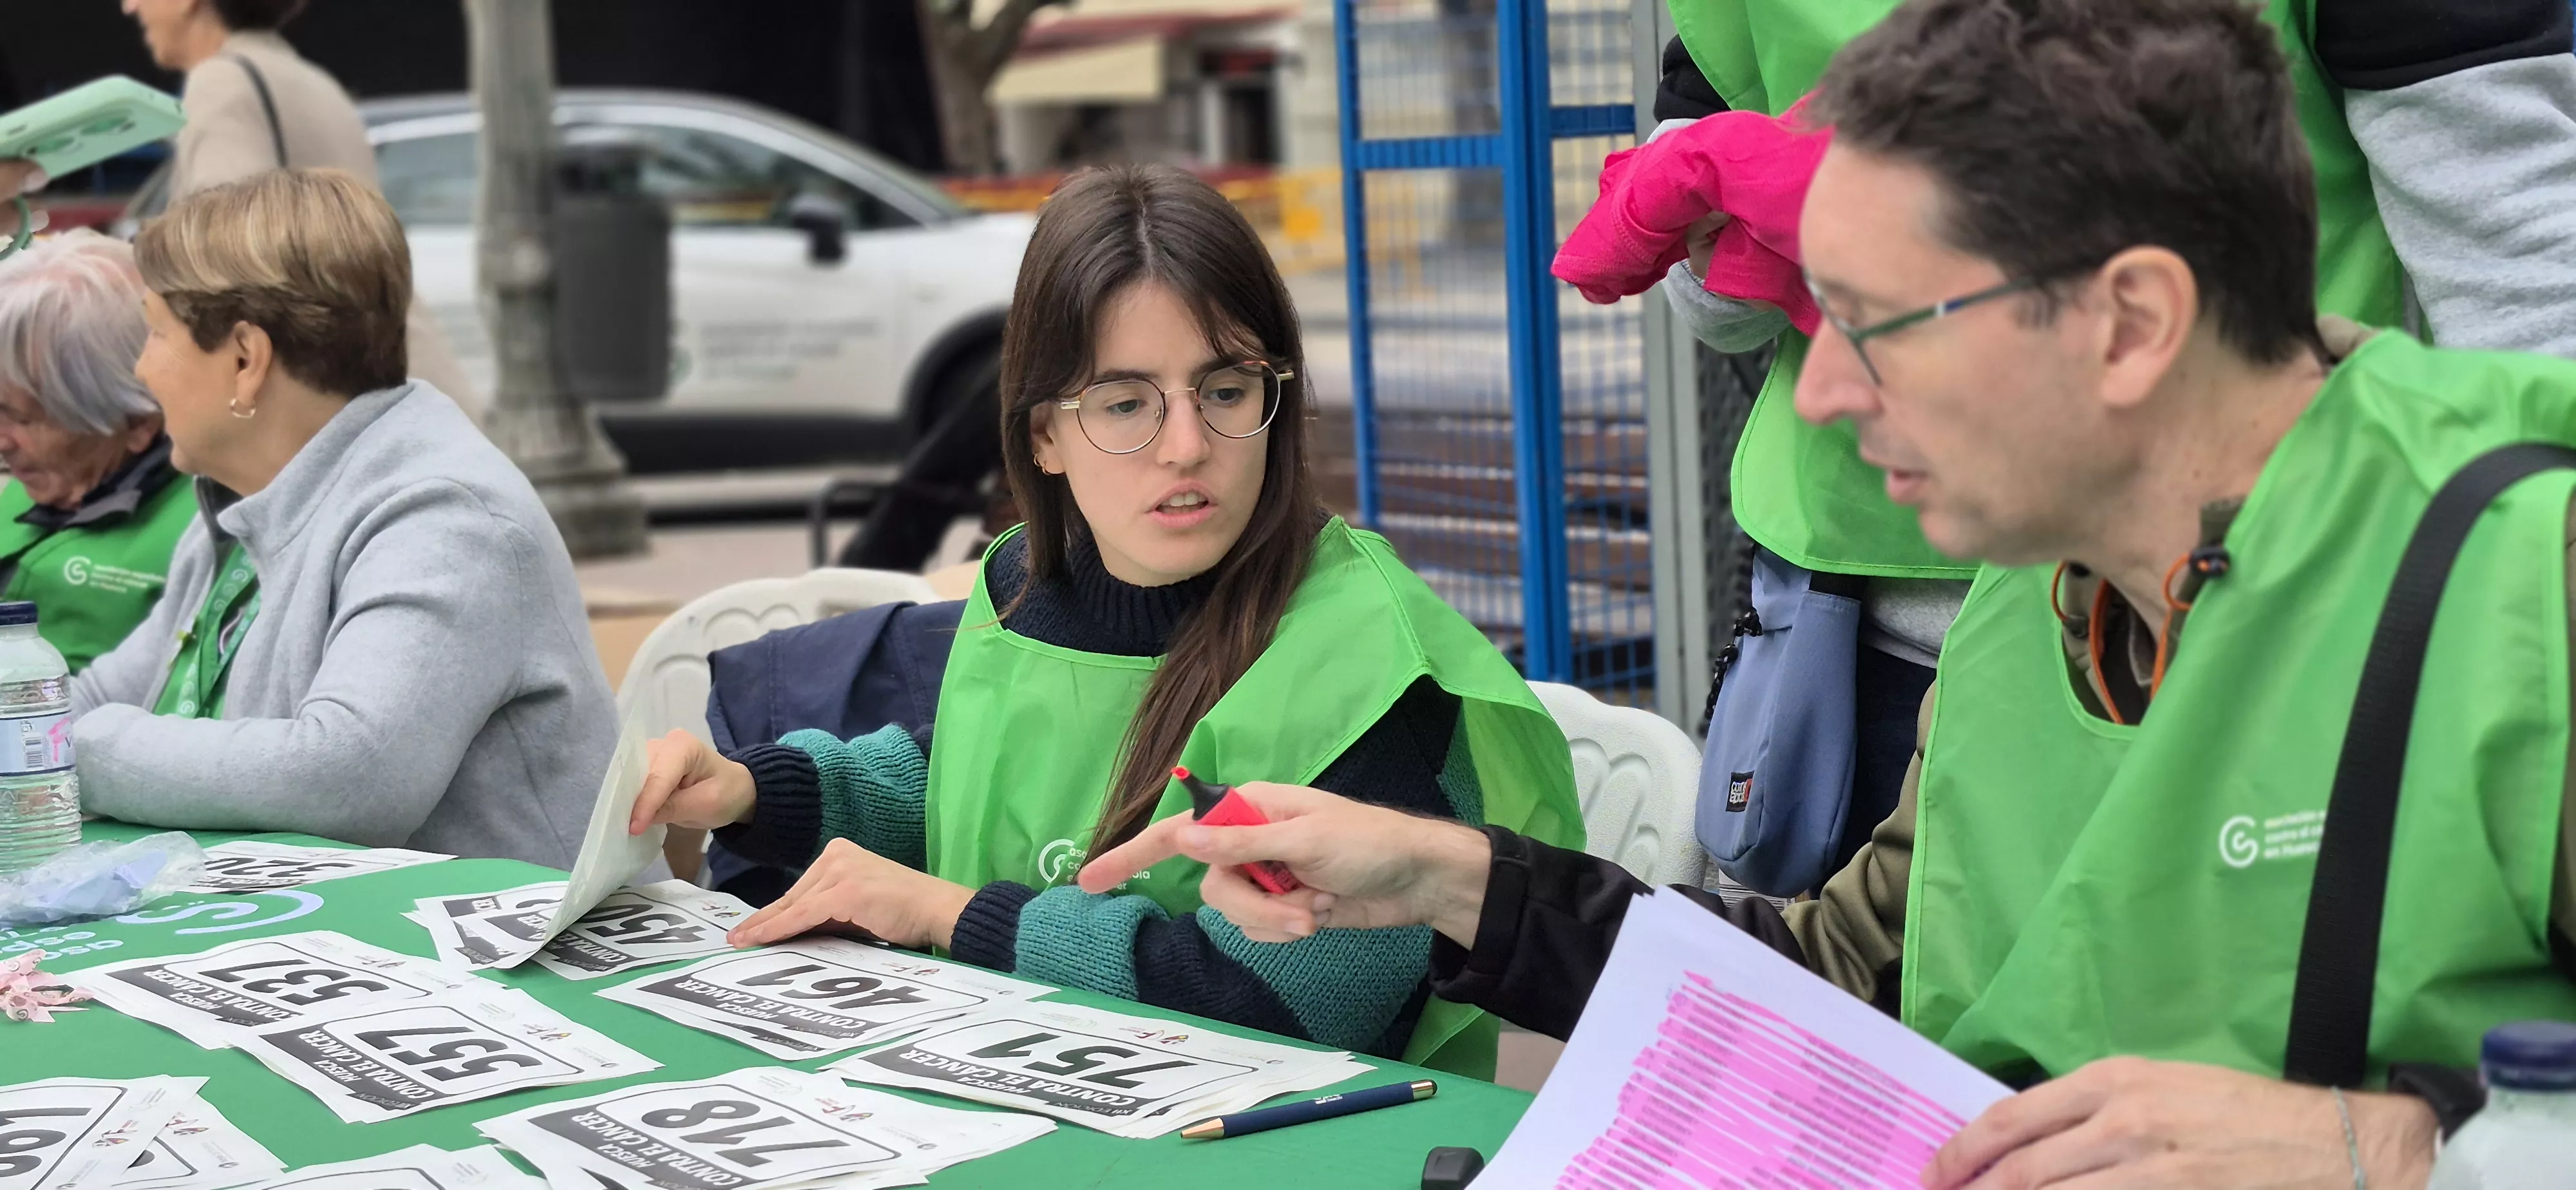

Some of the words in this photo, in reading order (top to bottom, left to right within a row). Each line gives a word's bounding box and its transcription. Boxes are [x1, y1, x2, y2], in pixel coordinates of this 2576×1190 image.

[572, 904, 708, 945] 450
[566, 939, 628, 963] CONTRA
[143, 968, 213, 999] CÁNCER
[198, 959, 390, 1006] 537
[674, 979, 757, 1004] CÁNCER
[735, 965, 931, 1010] 461
[168, 992, 221, 1011] HUESCA
[211, 990, 230, 1006] EL
[230, 996, 295, 1021] CONTRA
[758, 999, 783, 1013] EL
[715, 1002, 779, 1020] HUESCA
[783, 1005, 867, 1030] CONTRA
[298, 1028, 364, 1064] CÁNCER
[354, 1026, 542, 1081] 557
[312, 1058, 363, 1082] HUESCA
[362, 1059, 381, 1077] EL
[897, 1048, 999, 1079] CÁNCER
[965, 1033, 1198, 1089] 751
[373, 1068, 435, 1099] CONTRA
[956, 1075, 1032, 1094] HUESCA
[1003, 1072, 1032, 1088] EL
[1029, 1081, 1137, 1106] CONTRA
[570, 1111, 650, 1146] CÁNCER
[641, 1100, 851, 1168] 718
[596, 1143, 656, 1168] HUESCA
[649, 1142, 672, 1162] EL
[663, 1151, 744, 1185] CONTRA
